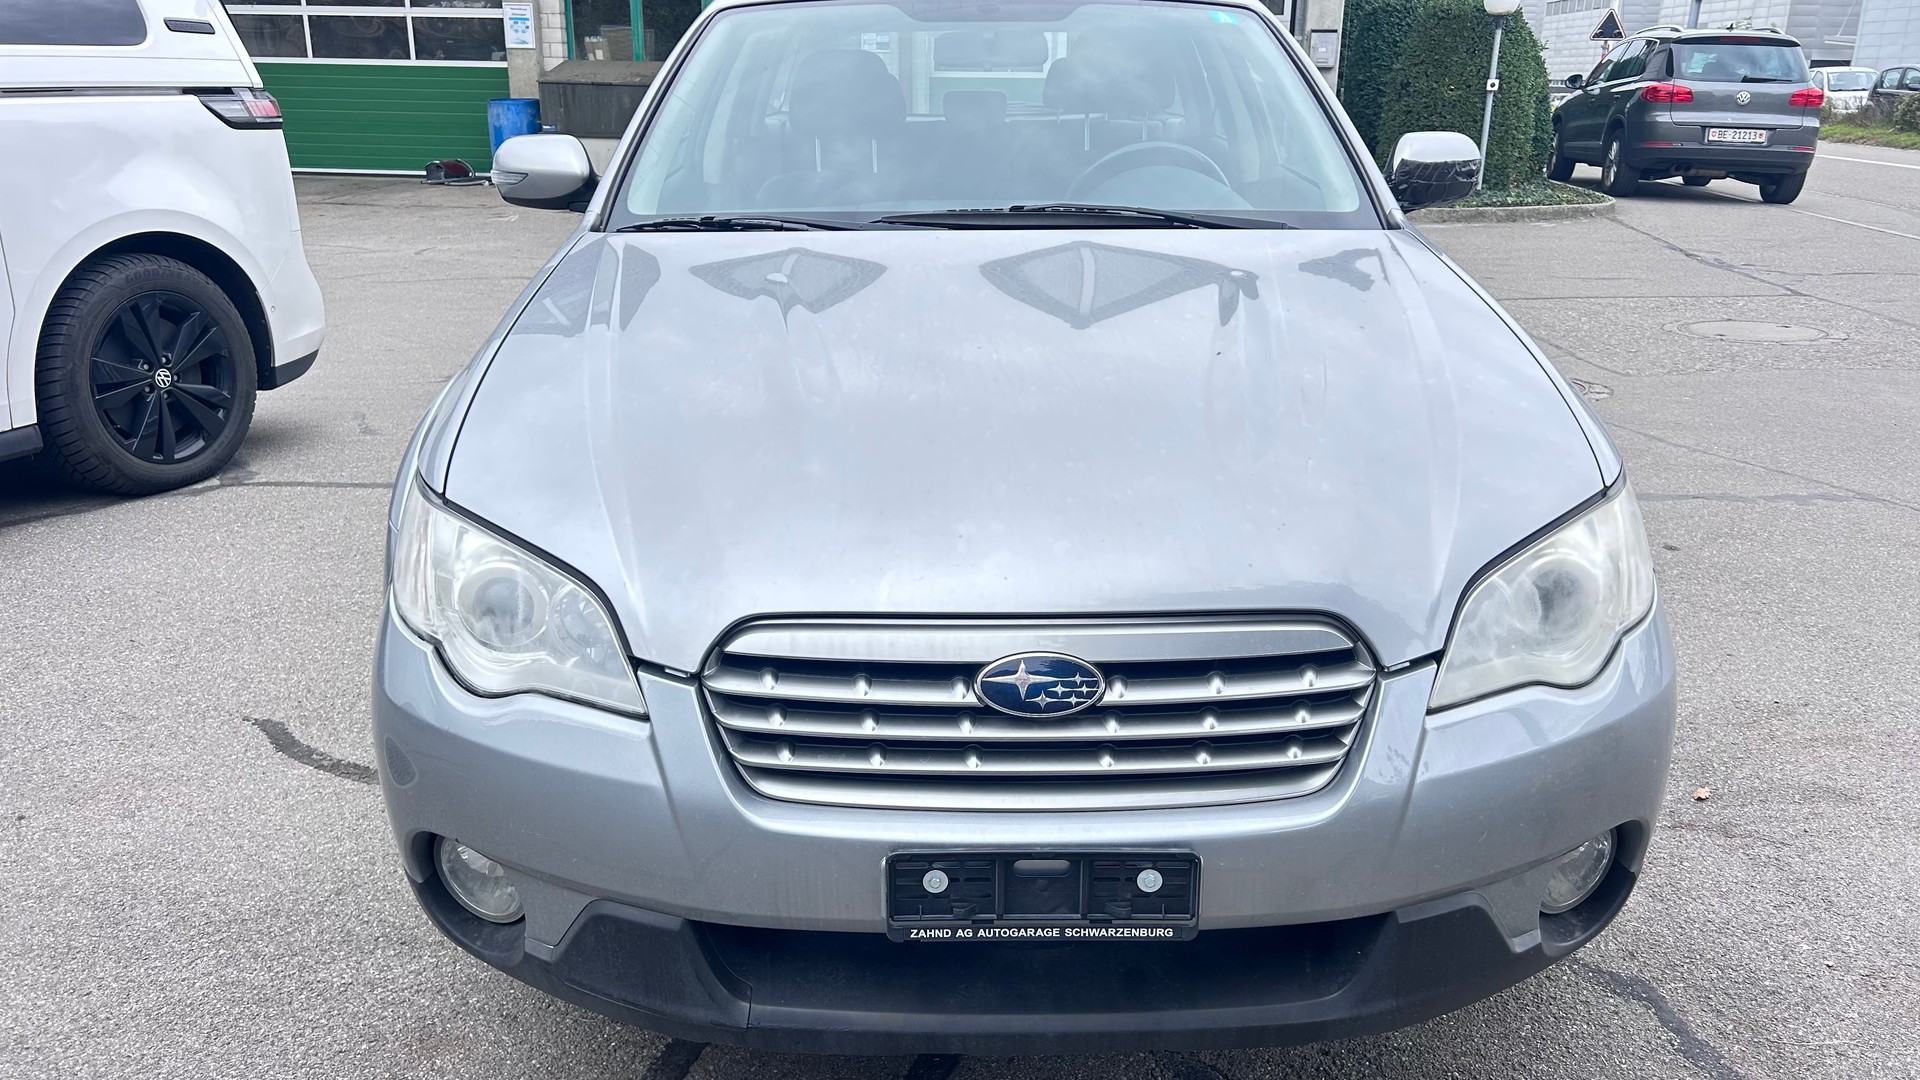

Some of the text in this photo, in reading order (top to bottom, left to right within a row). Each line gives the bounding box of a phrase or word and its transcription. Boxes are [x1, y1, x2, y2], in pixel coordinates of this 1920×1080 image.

[910, 928, 1174, 938] ZAHND AG AUTOGARAGE SCHWARZENBURG
